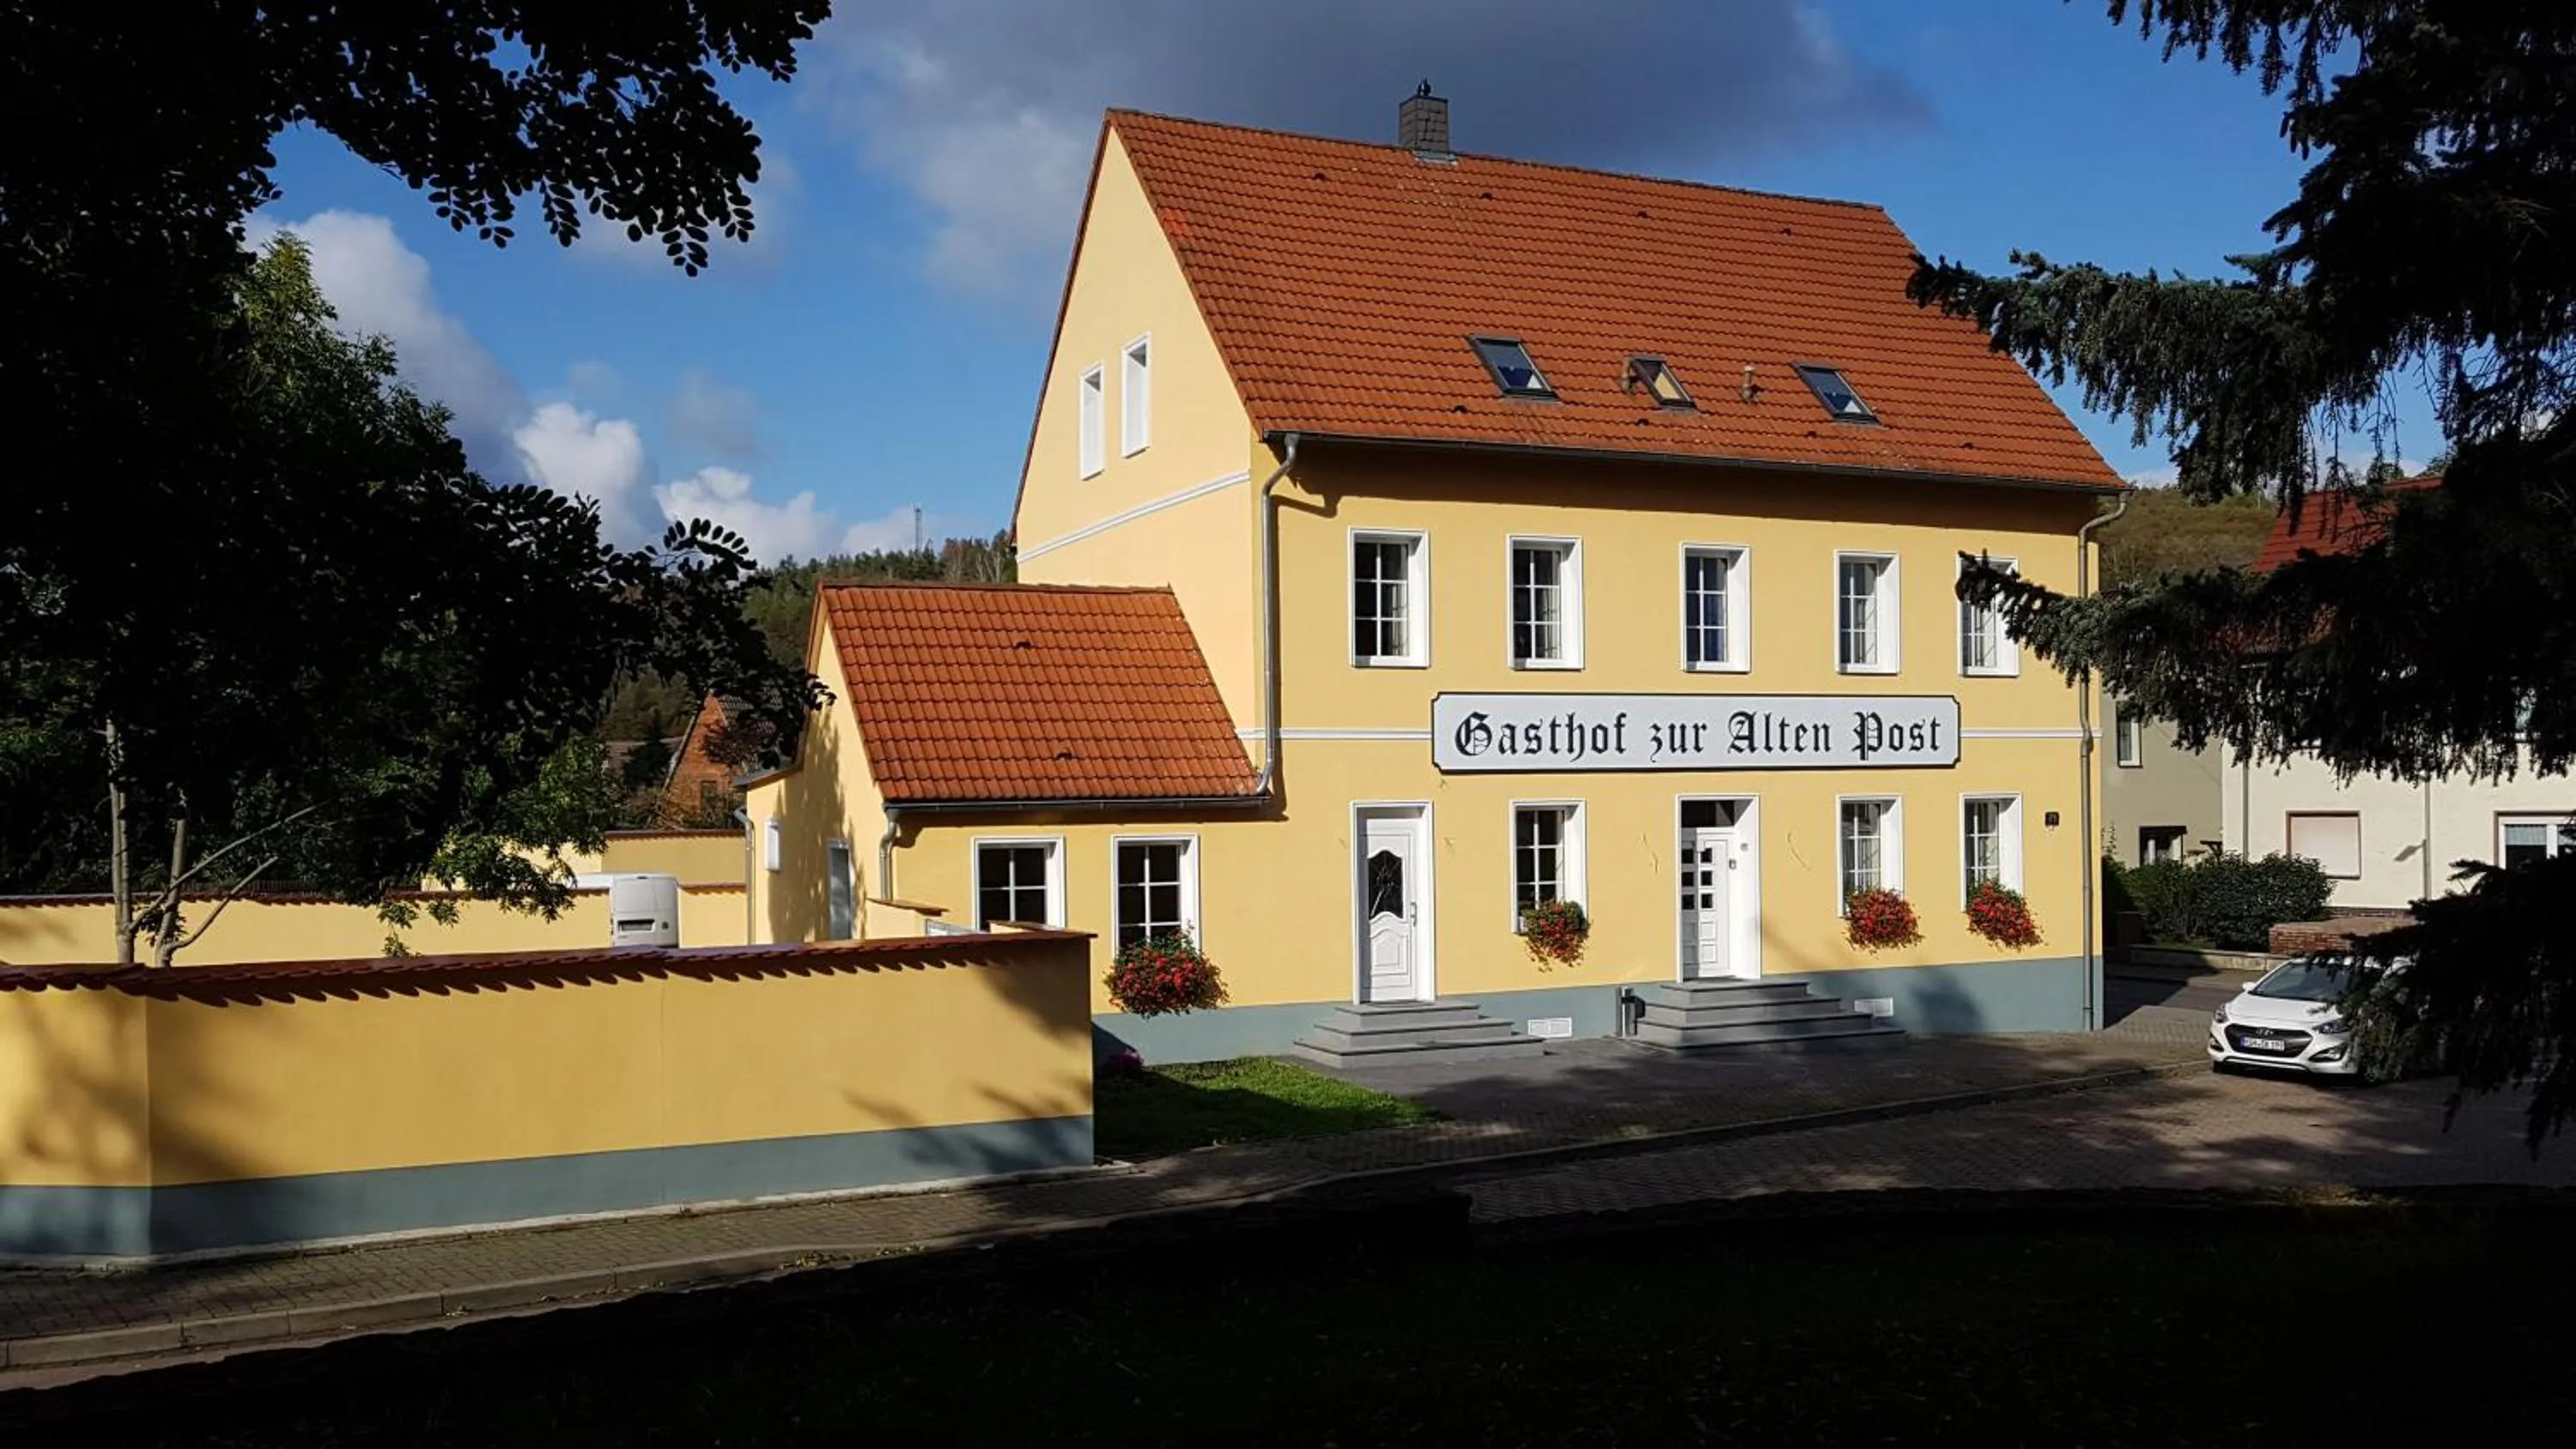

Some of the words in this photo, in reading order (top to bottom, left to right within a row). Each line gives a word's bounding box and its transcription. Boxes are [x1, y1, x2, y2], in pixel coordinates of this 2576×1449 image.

[1455, 711, 1627, 761] Gasthof
[1649, 722, 1708, 763] zur
[1728, 711, 1832, 754] Alten
[1851, 710, 1942, 761] Post
